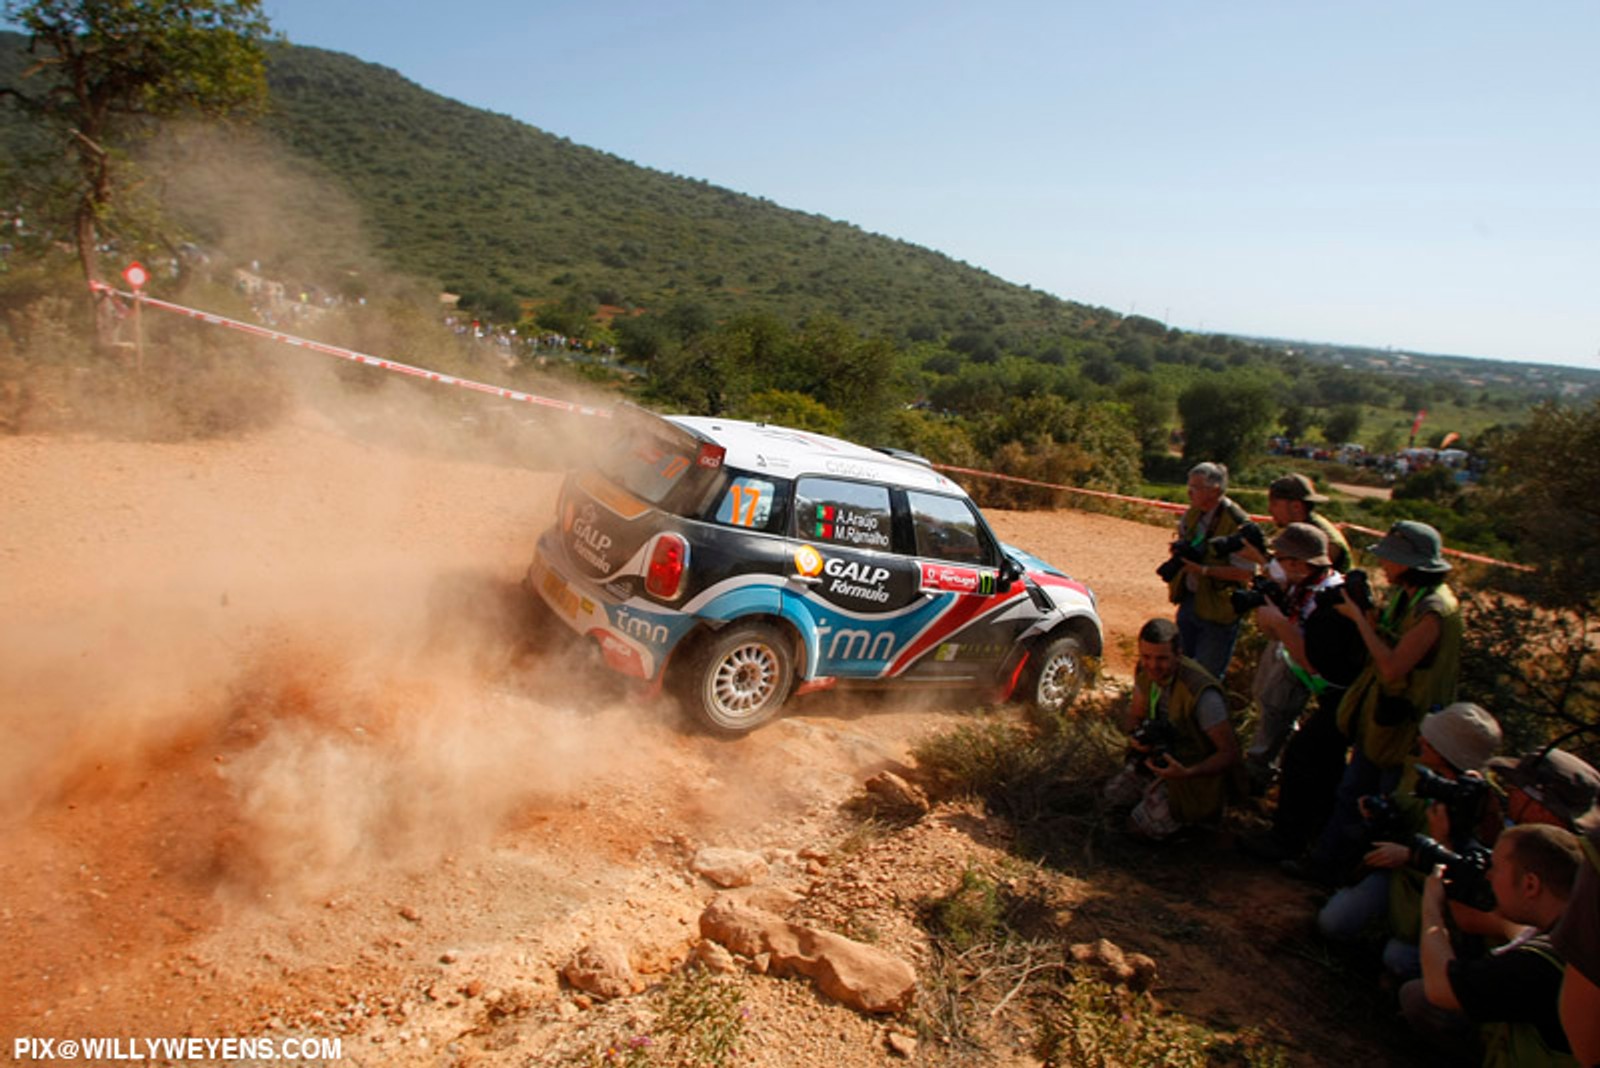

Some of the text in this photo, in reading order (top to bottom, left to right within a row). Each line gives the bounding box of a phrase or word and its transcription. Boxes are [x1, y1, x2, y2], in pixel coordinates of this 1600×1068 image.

[661, 455, 690, 479] 17
[730, 484, 761, 527] 17
[573, 518, 611, 550] GALP
[825, 558, 890, 585] GALP
[829, 579, 890, 602] Fórmula
